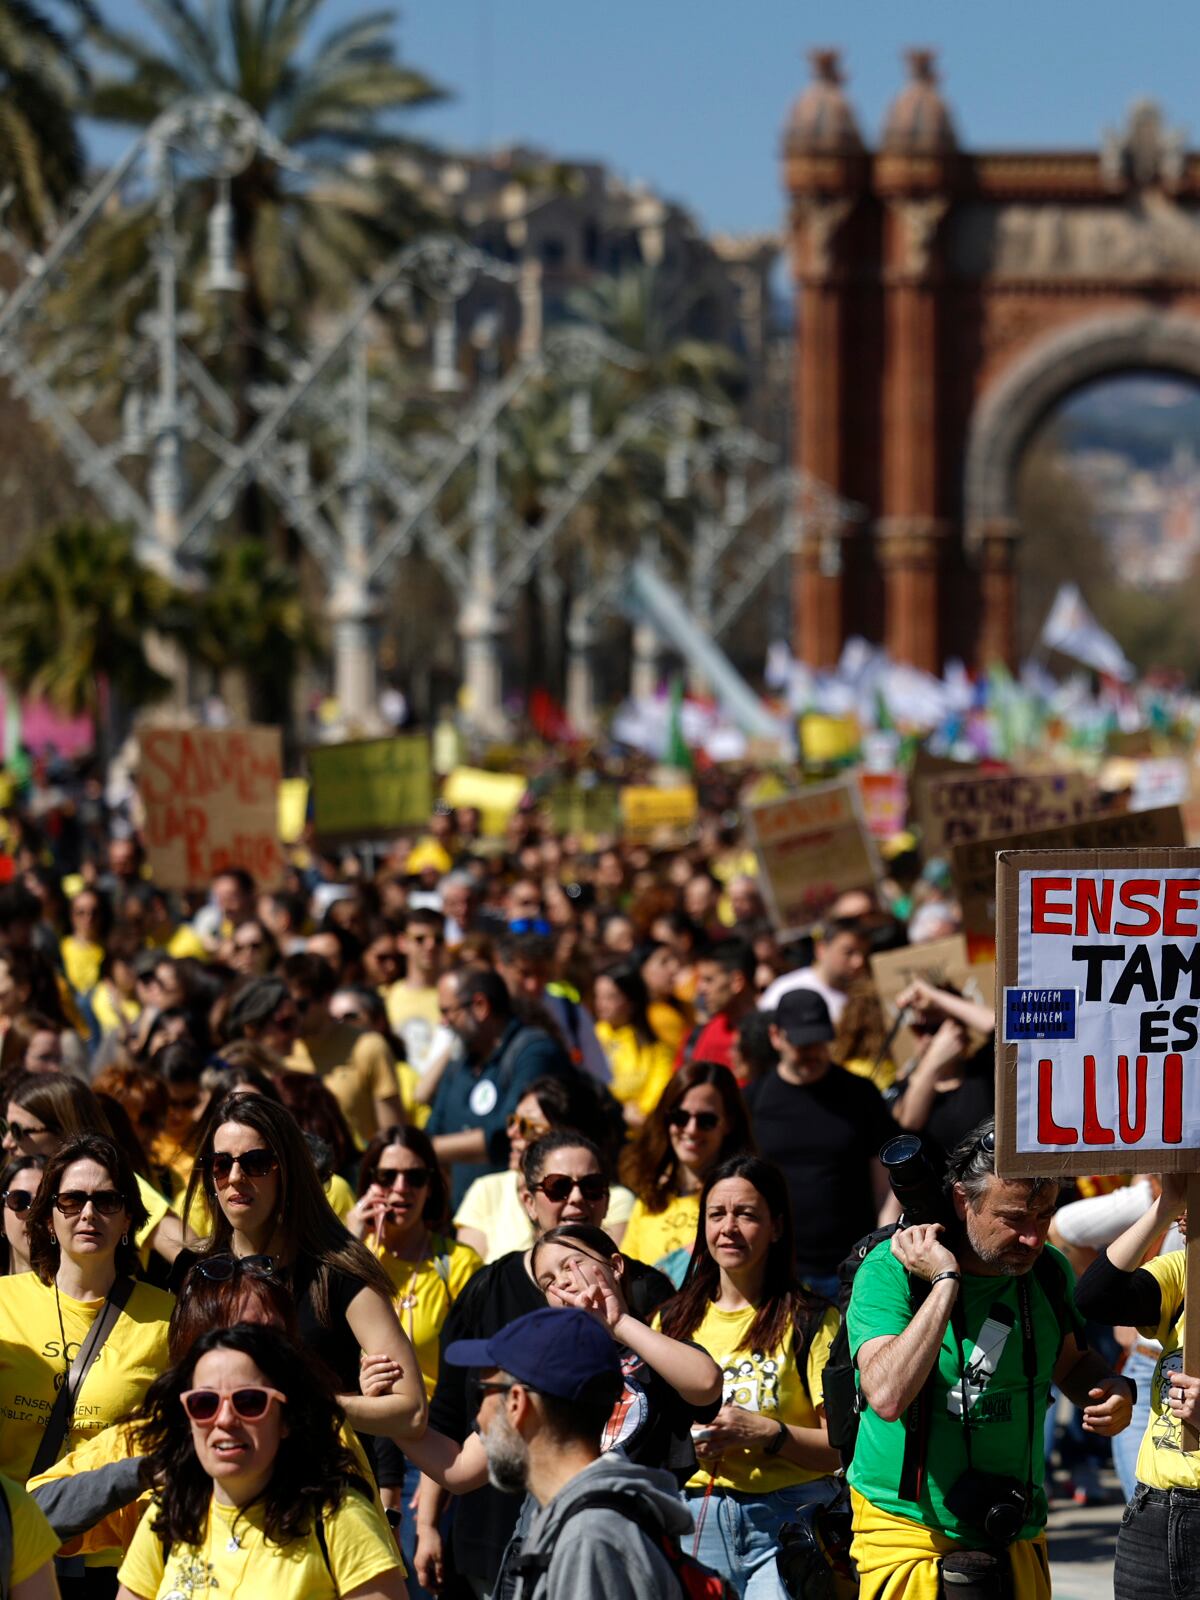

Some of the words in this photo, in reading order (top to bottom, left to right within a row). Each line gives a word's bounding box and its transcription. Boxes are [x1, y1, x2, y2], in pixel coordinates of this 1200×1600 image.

[1021, 991, 1061, 1003] APUGEM
[1020, 1012, 1062, 1023] ABAIXEM
[1140, 1003, 1198, 1053] ÉS
